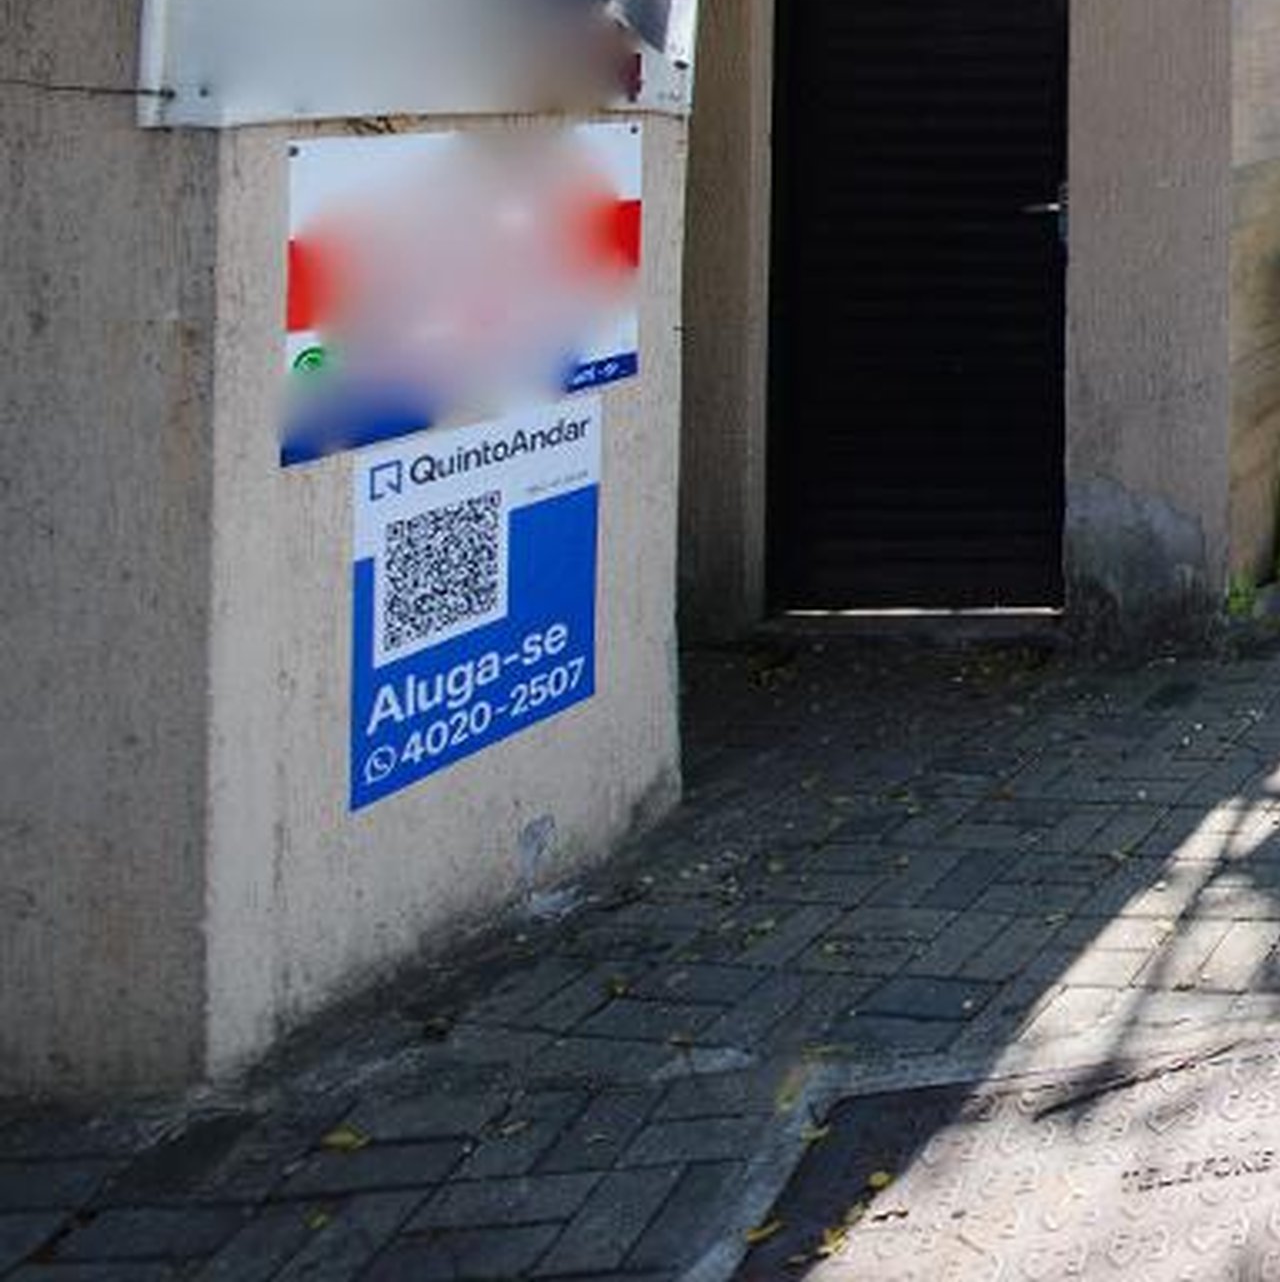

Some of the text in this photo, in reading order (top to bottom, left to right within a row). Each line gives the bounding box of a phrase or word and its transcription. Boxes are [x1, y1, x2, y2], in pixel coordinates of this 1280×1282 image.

[409, 417, 591, 485] QuintoAndar
[365, 622, 569, 736] Aluga-se
[400, 656, 585, 764] 4020-2507
